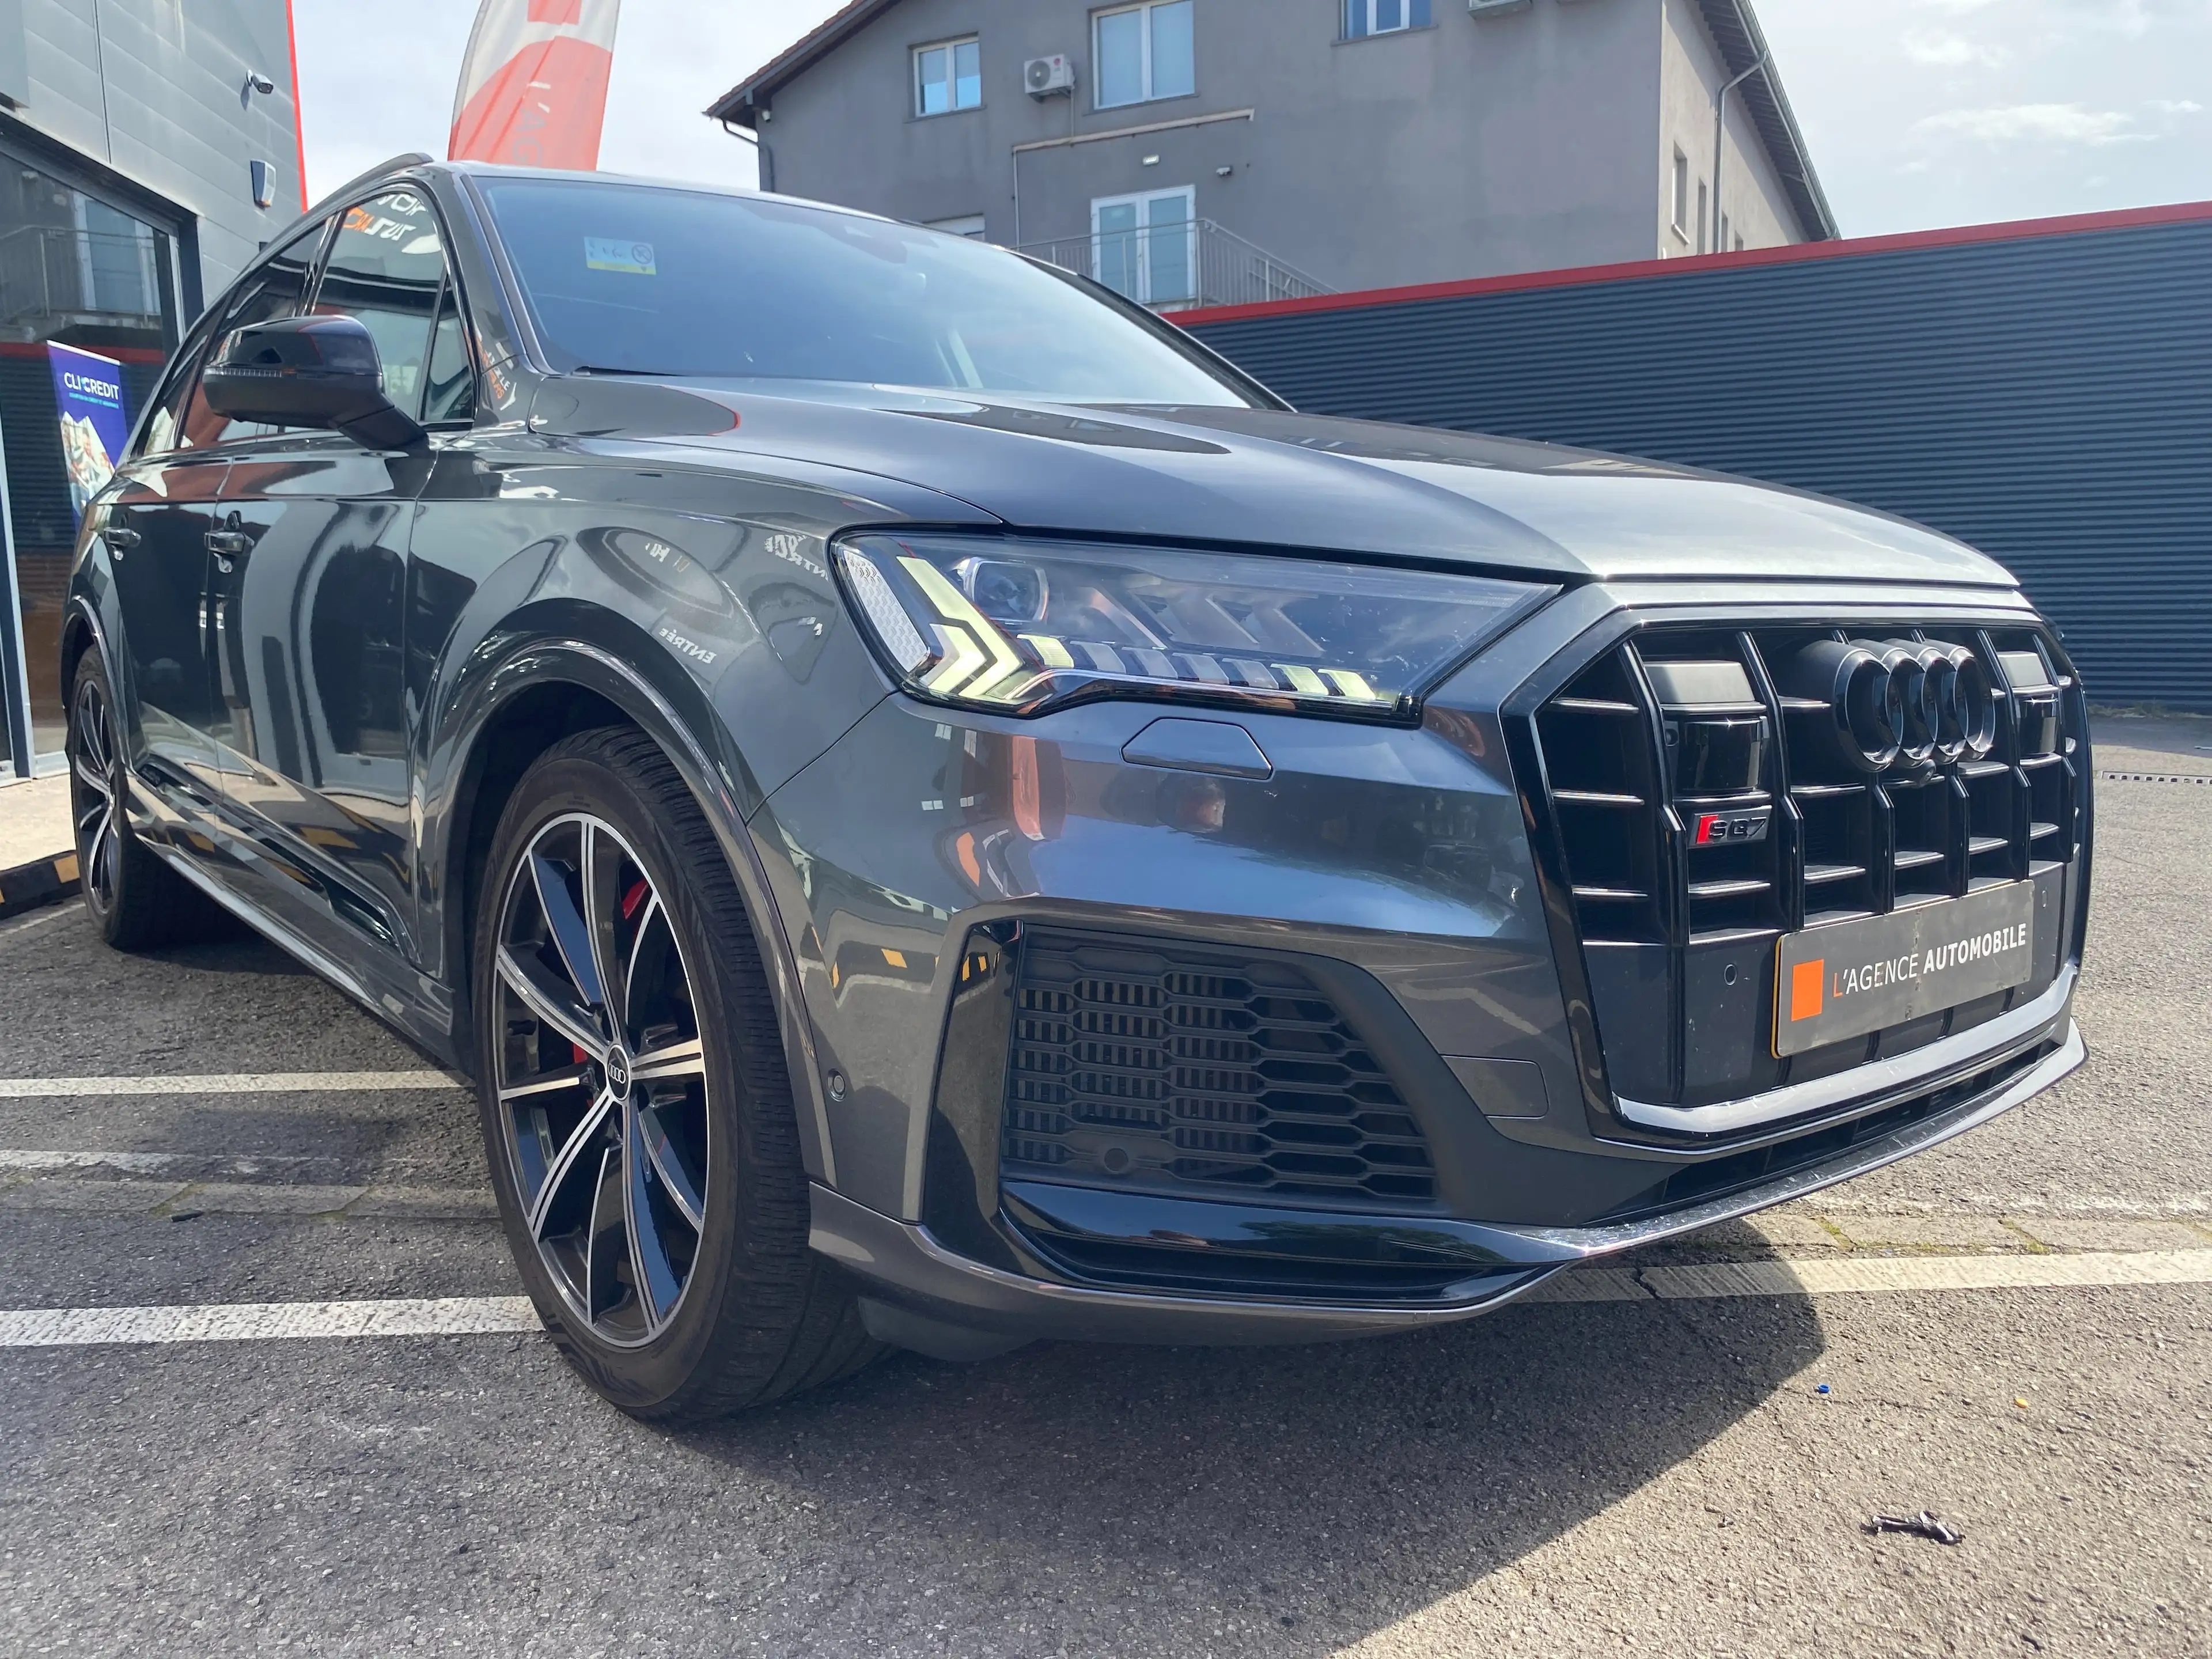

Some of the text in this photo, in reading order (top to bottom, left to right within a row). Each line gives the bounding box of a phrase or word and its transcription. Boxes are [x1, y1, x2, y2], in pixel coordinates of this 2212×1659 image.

[1709, 816, 1767, 839] SQ7
[1833, 922, 2027, 998] L'AGENCE AUTOMOBILE
